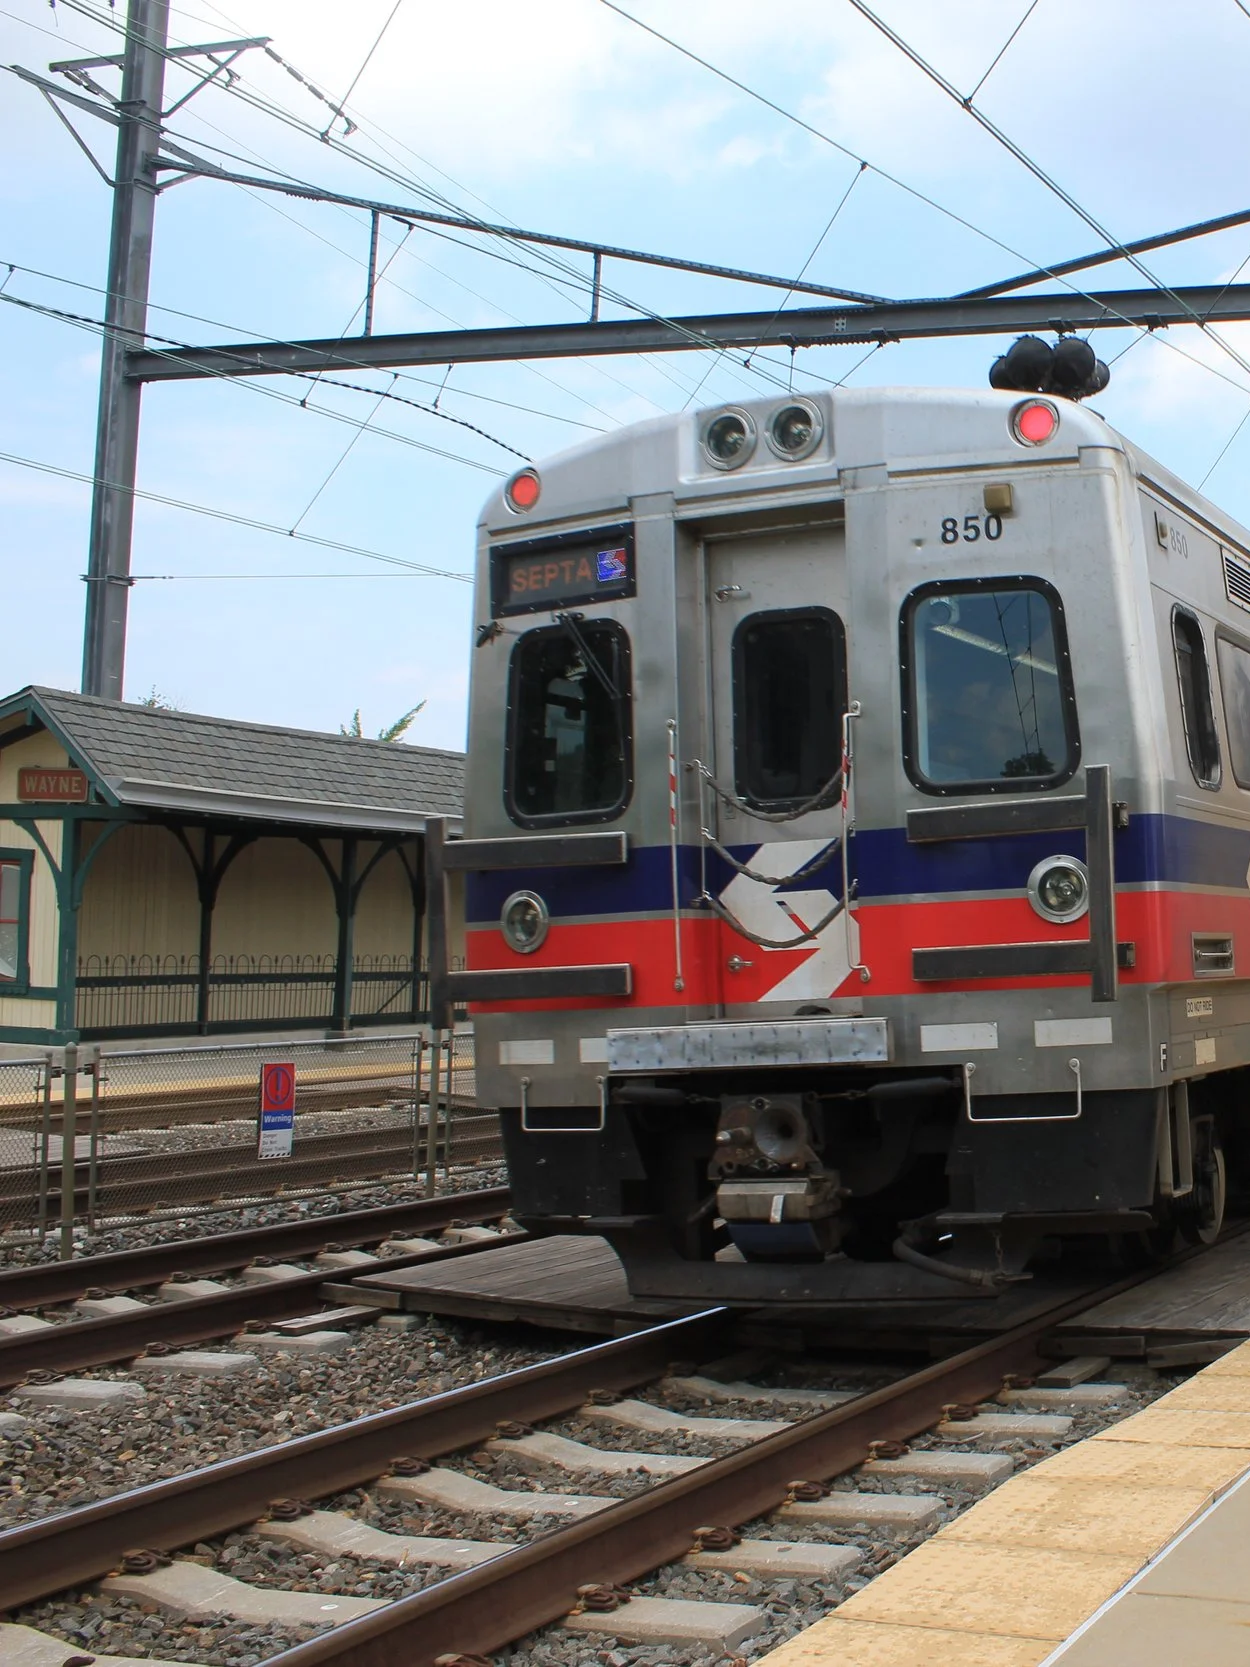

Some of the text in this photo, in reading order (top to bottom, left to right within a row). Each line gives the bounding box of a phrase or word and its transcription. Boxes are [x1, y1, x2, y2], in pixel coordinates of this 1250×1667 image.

[941, 514, 1002, 545] 850
[1170, 527, 1188, 560] 850
[511, 557, 593, 593] SEPTA
[24, 776, 82, 793] WAYNE
[1160, 1043, 1167, 1071] F
[264, 1113, 292, 1124] Warning
